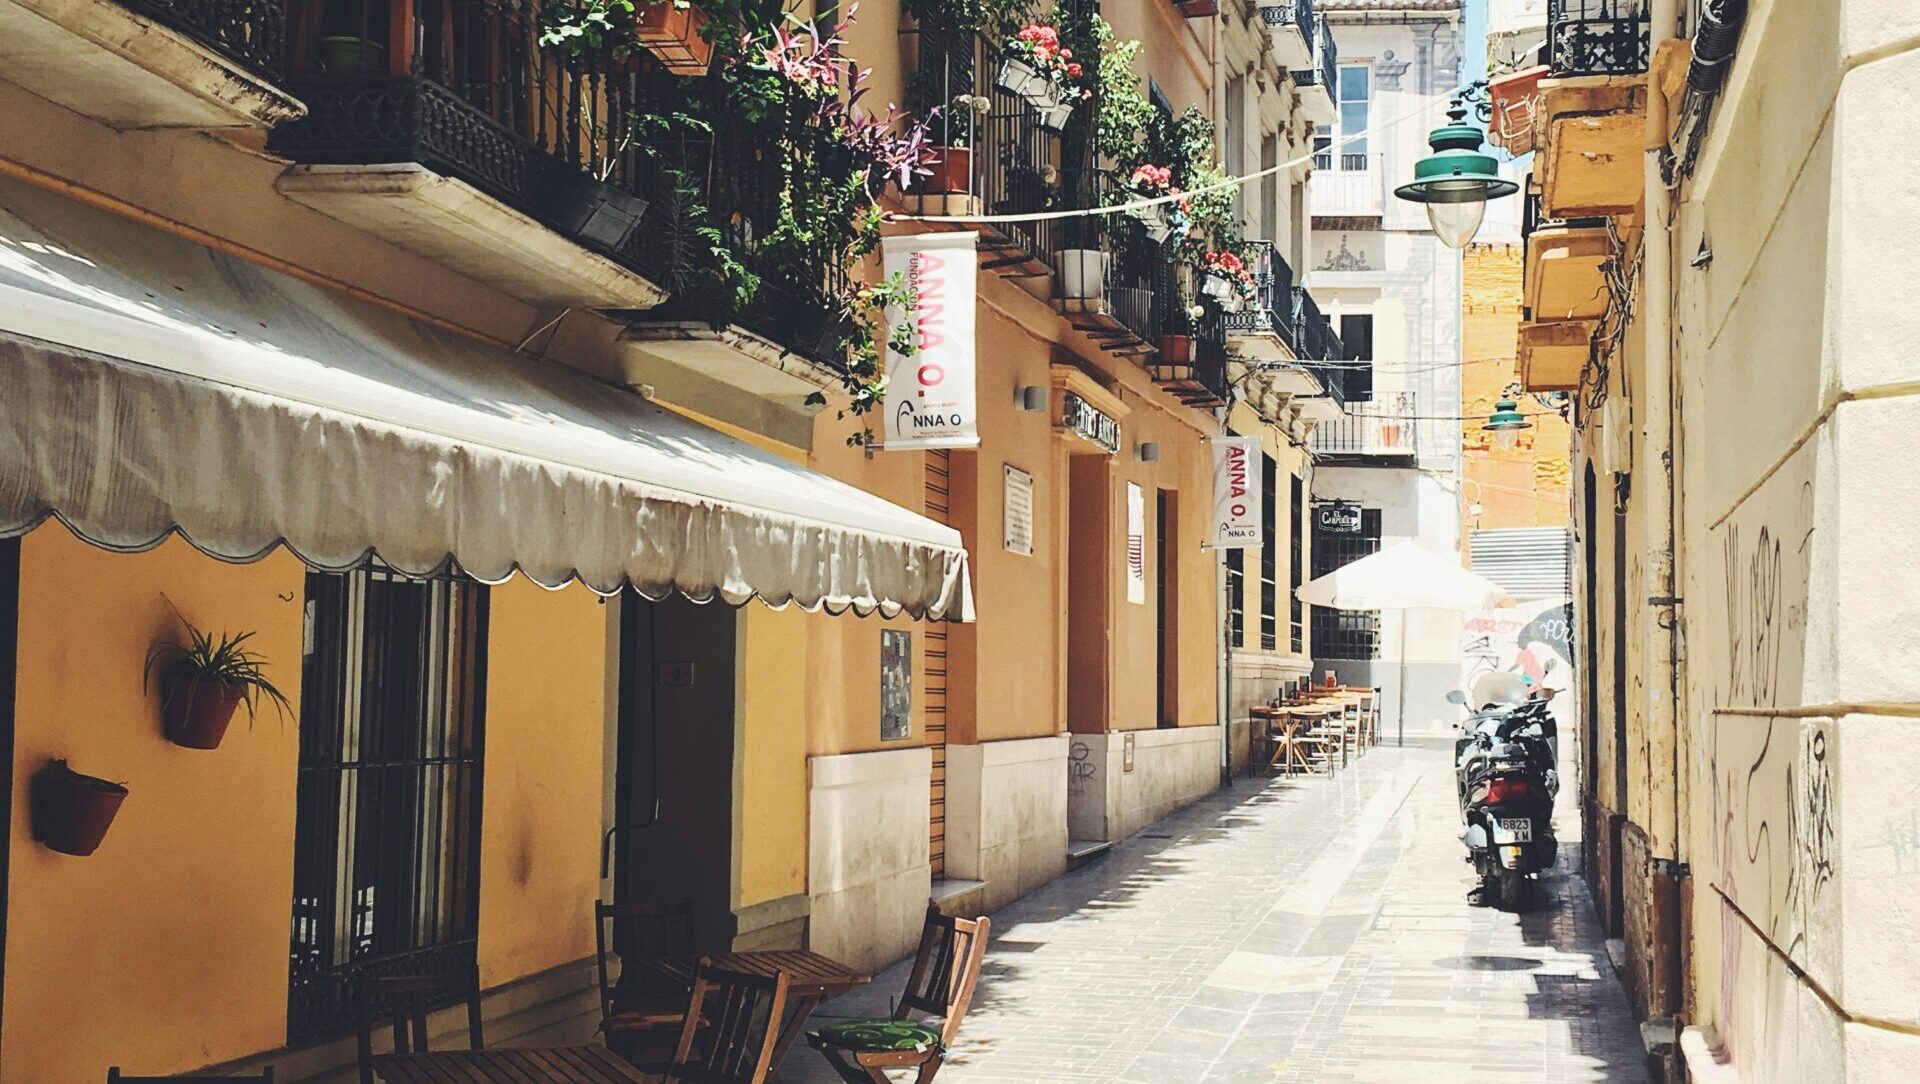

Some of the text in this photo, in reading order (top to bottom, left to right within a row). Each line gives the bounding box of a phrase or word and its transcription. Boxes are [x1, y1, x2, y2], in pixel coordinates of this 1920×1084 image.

[909, 252, 919, 312] FUNDACON
[917, 251, 945, 350] ANNA
[917, 364, 945, 397] O.
[950, 413, 962, 426] O
[1231, 446, 1246, 499] ANNA
[1503, 819, 1529, 830] 6823
